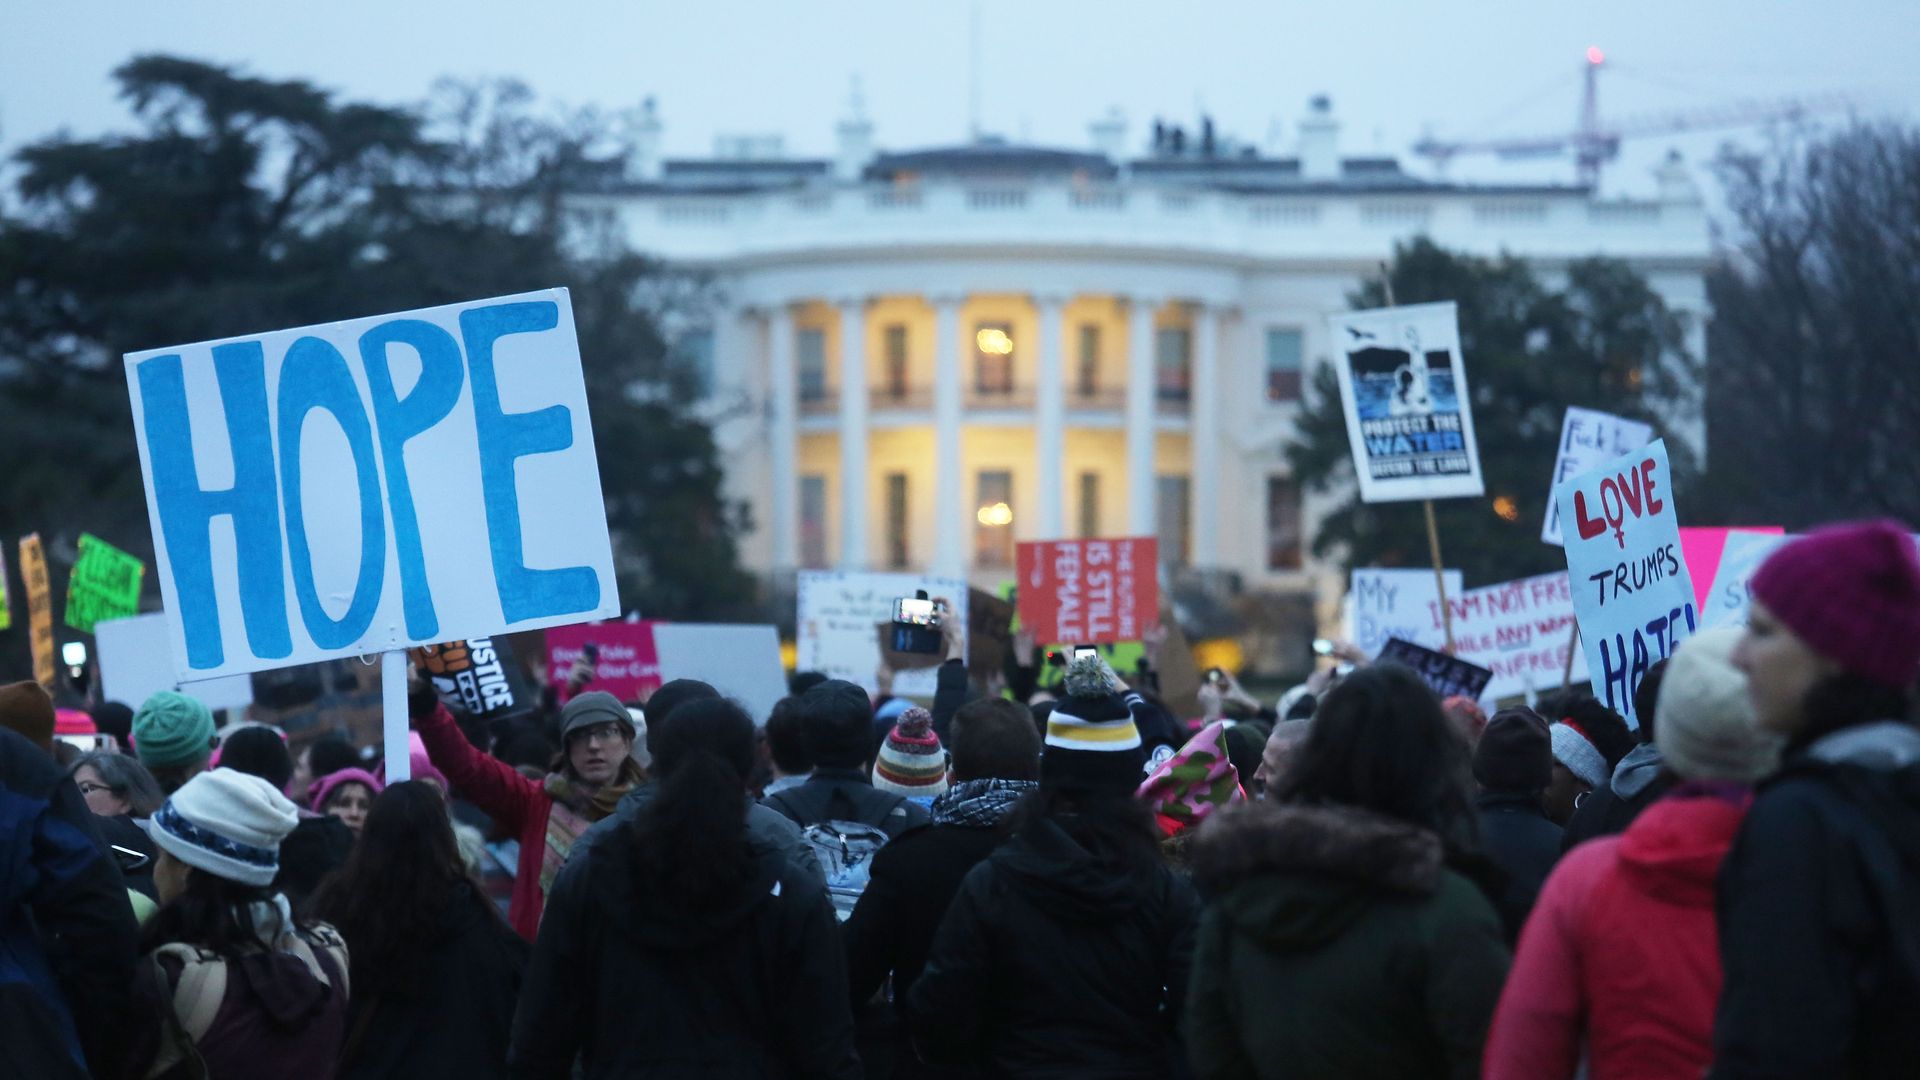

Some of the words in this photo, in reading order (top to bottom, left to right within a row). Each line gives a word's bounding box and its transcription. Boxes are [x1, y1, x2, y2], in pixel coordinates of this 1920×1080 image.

[1362, 417, 1428, 437] PROTECT
[1432, 413, 1460, 431] THE
[1366, 431, 1462, 457] WATER
[137, 300, 600, 670] HOPE
[1574, 458, 1663, 548] LOVE
[1086, 542, 1112, 565] IS
[1589, 543, 1679, 606] TRUMPS
[1055, 543, 1082, 641] FEMALE
[1087, 571, 1113, 641] STILL
[1486, 580, 1528, 618] NOT
[1530, 577, 1571, 609] FRE
[459, 674, 481, 712] FOR
[466, 638, 514, 711] USTICE
